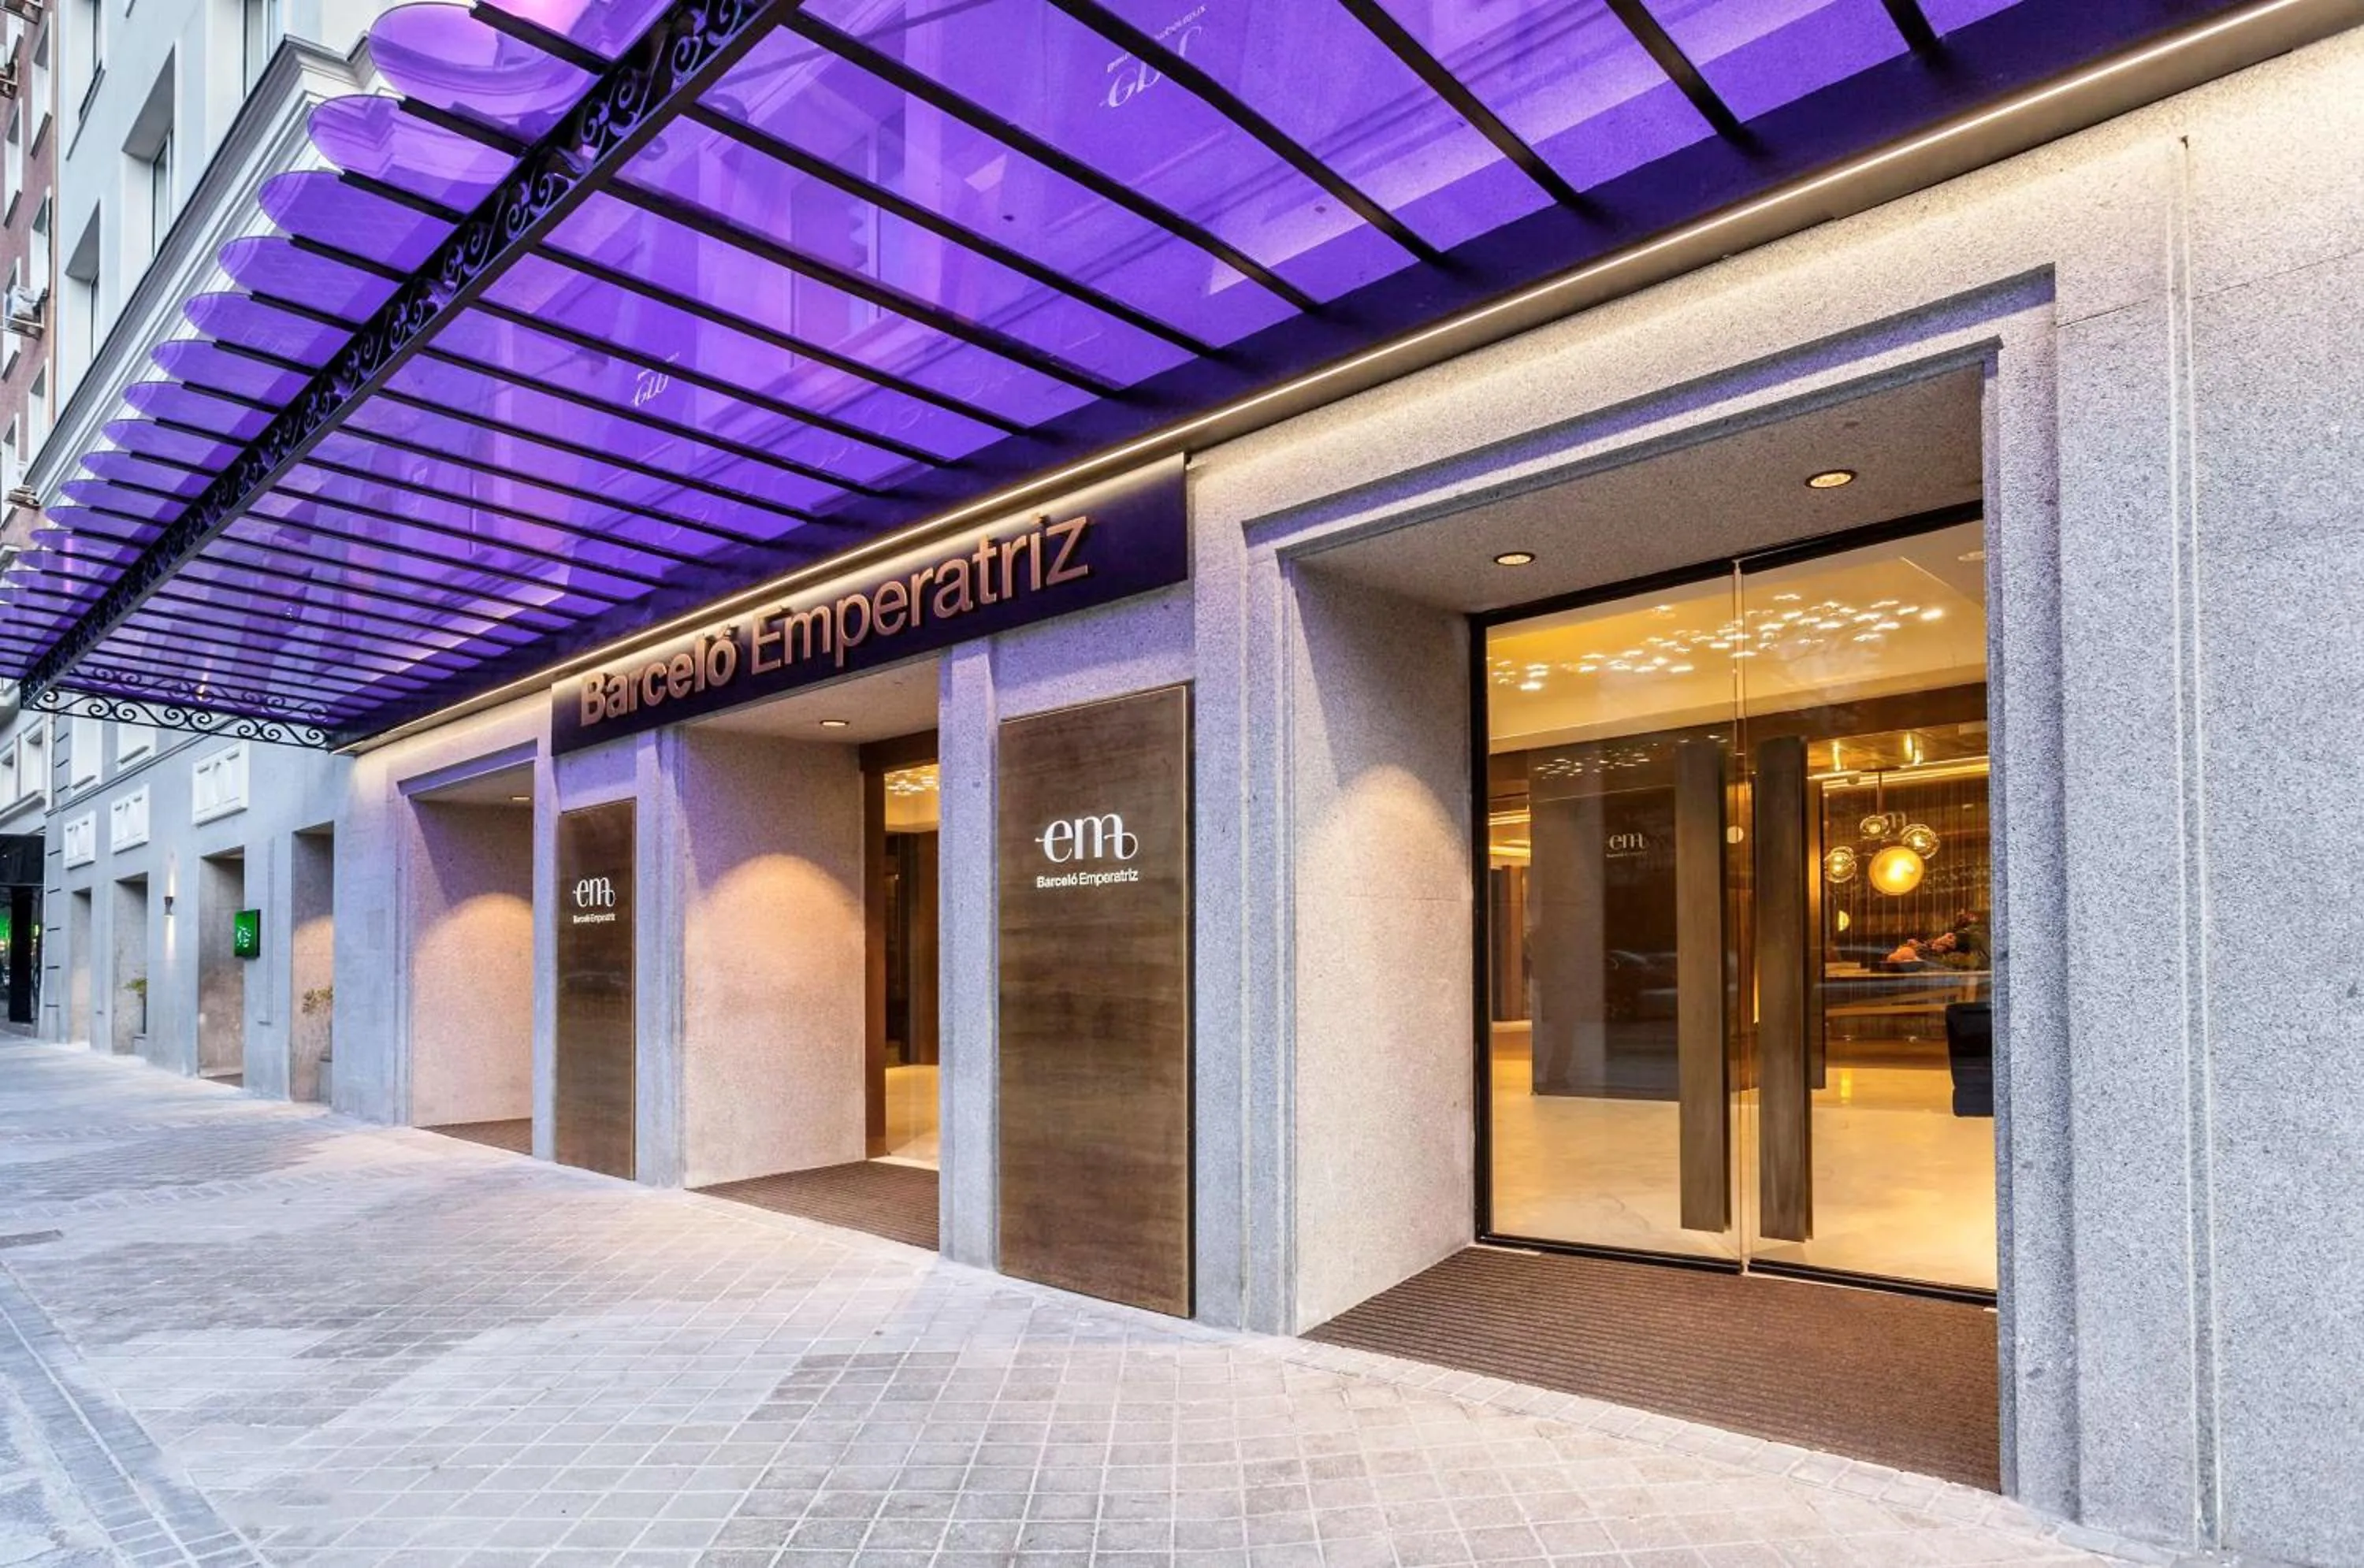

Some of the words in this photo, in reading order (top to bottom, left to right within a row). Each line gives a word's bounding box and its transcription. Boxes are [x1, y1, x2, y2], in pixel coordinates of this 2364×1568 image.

[579, 622, 739, 726] Barceló
[750, 513, 1090, 674] Emperatriz
[1036, 872, 1077, 888] Barceló
[1079, 868, 1139, 886] Emperatriz
